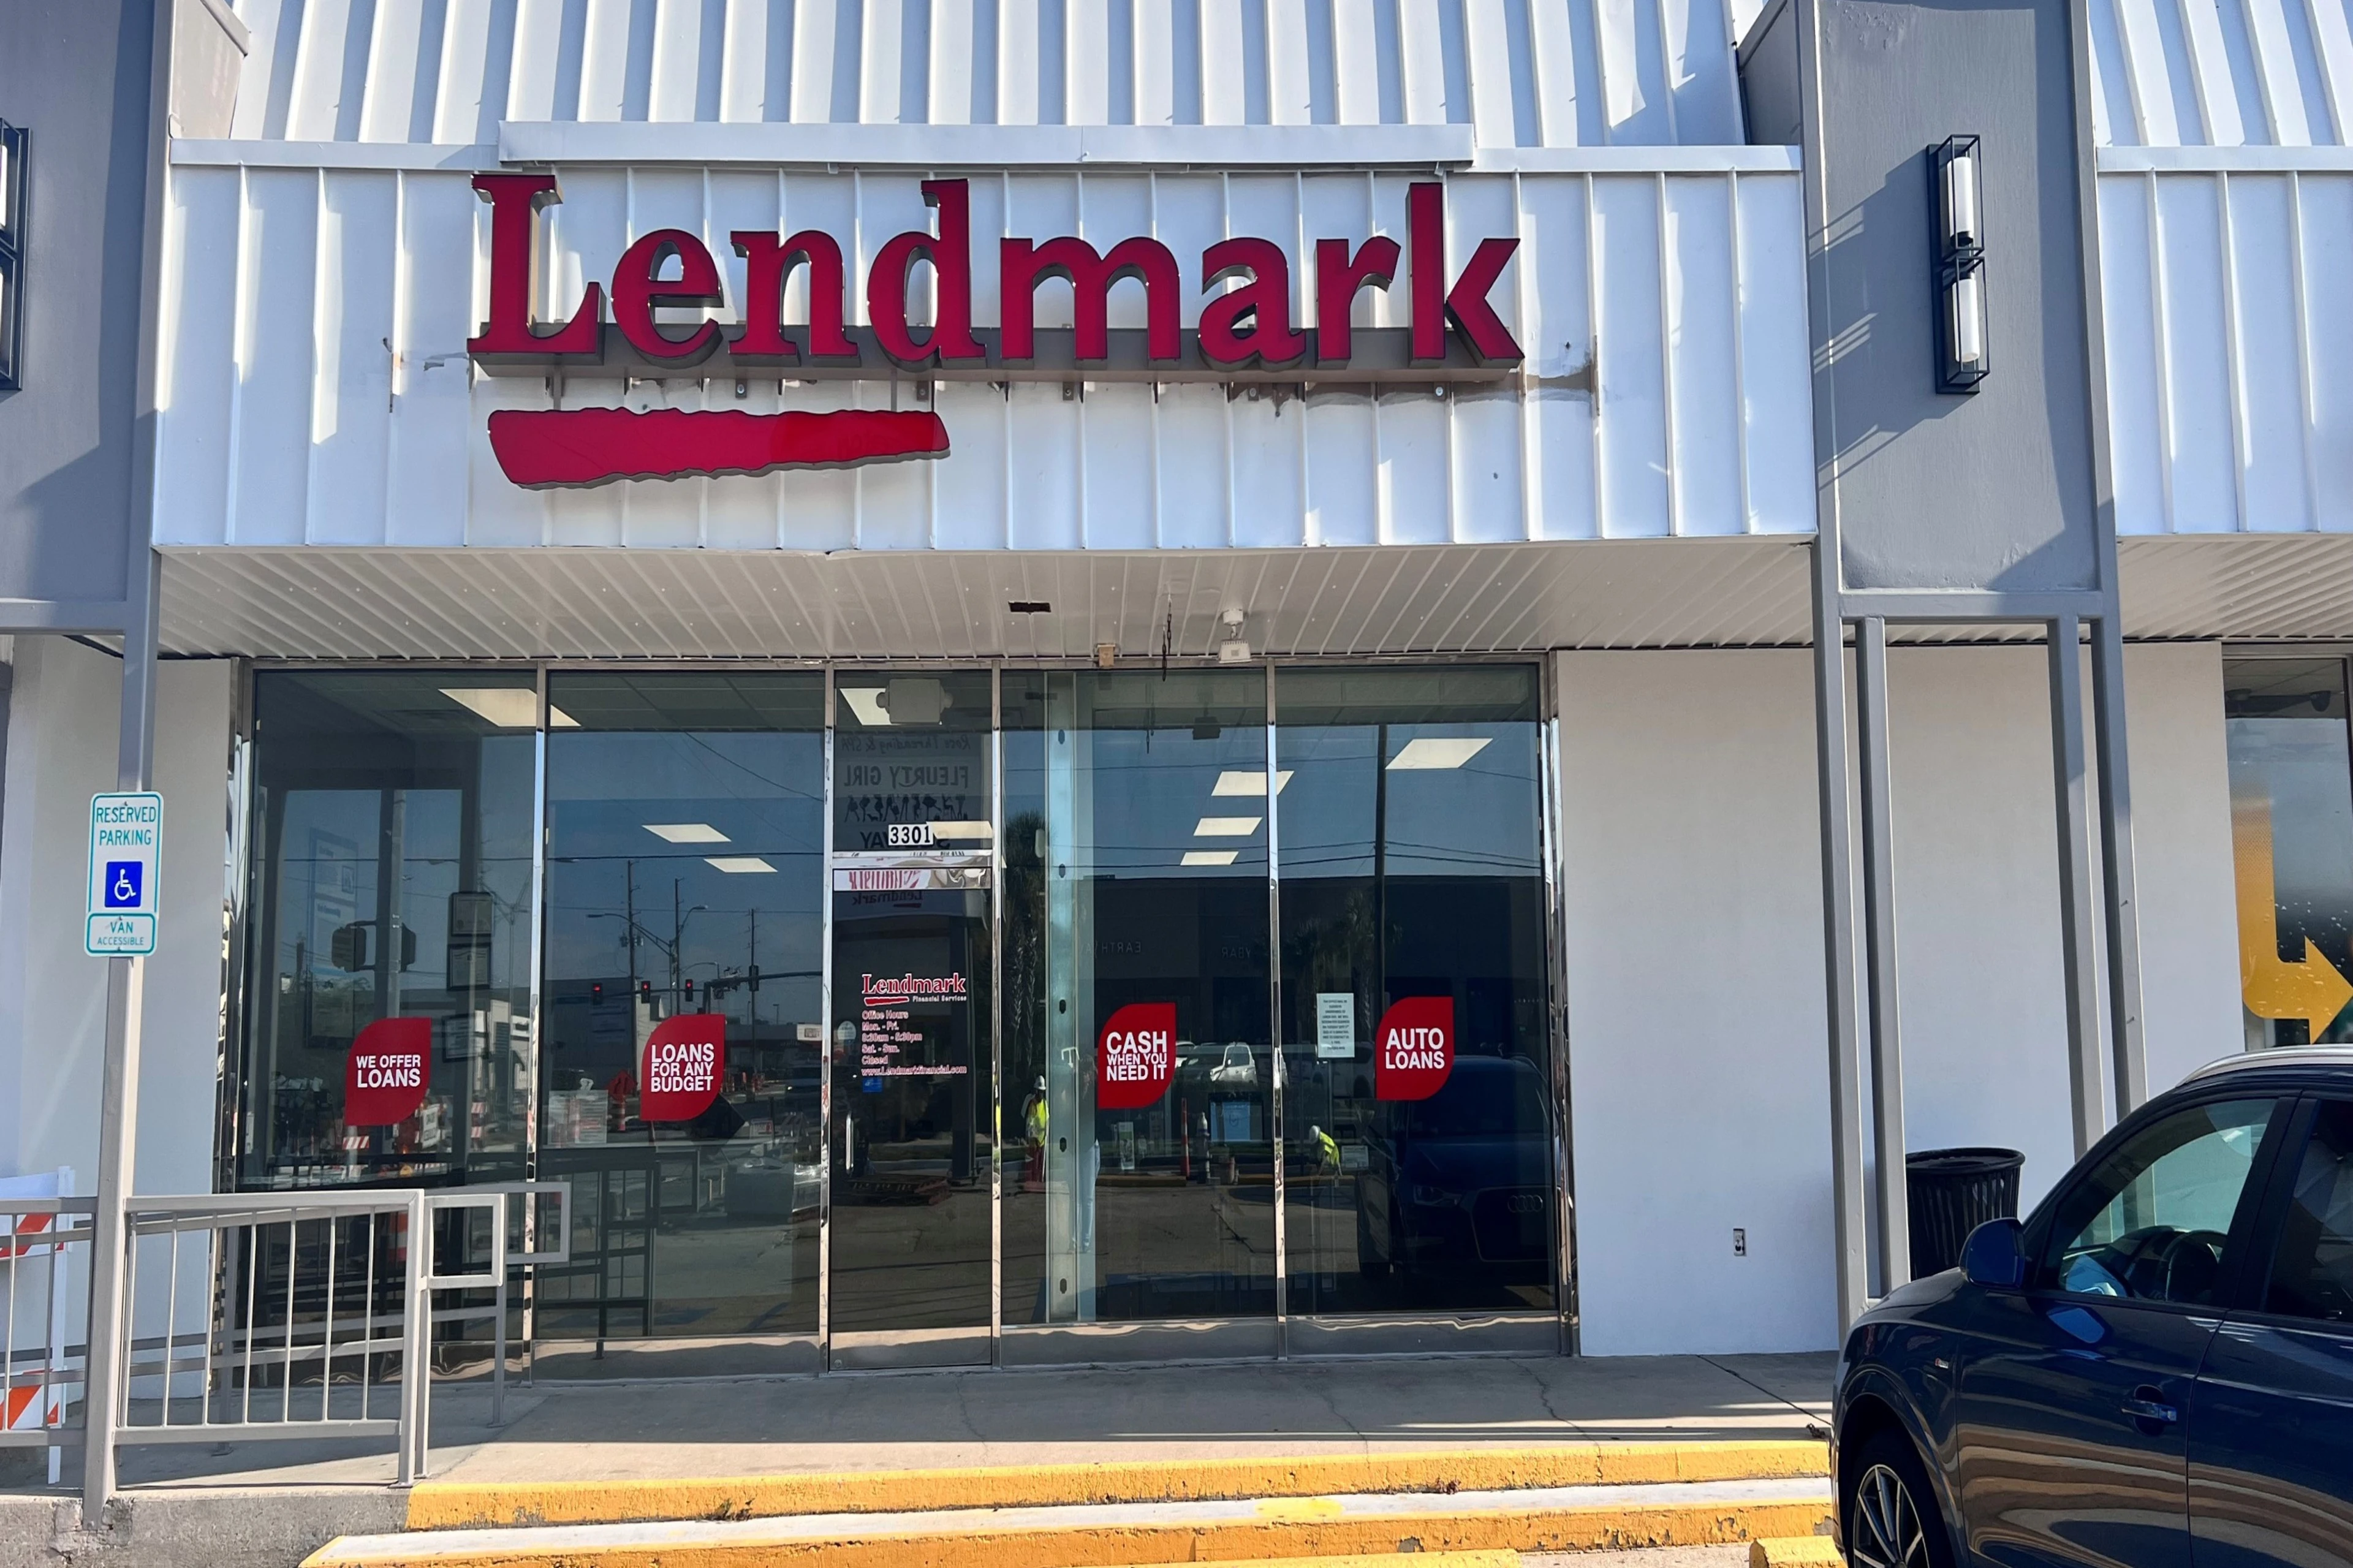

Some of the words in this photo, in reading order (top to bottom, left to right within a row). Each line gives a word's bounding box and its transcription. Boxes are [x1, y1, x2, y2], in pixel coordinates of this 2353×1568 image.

[467, 174, 1525, 370] Lendmark
[96, 806, 156, 823] RESERVED
[99, 829, 151, 846] PARKING
[890, 825, 930, 844] 3301
[110, 922, 133, 934] VAN
[97, 937, 144, 945] ACCESSIBLE
[862, 972, 966, 994] Lendmark
[885, 1010, 909, 1019] Hours
[1106, 1031, 1167, 1054] CASH
[1385, 1028, 1444, 1050] AUTO
[651, 1043, 714, 1062] LOANS
[862, 1055, 889, 1065] Closed
[1106, 1053, 1140, 1066] WHEN
[1143, 1053, 1167, 1064] YOU
[1385, 1051, 1445, 1069] LOANS
[356, 1055, 376, 1069] WE
[379, 1055, 421, 1068] OFFER
[651, 1062, 680, 1077] FOR
[684, 1062, 714, 1076] ANY
[357, 1069, 421, 1088] LOANS
[1106, 1065, 1149, 1081] NEED
[1153, 1064, 1167, 1080] IT
[651, 1076, 714, 1093] BUDGET
